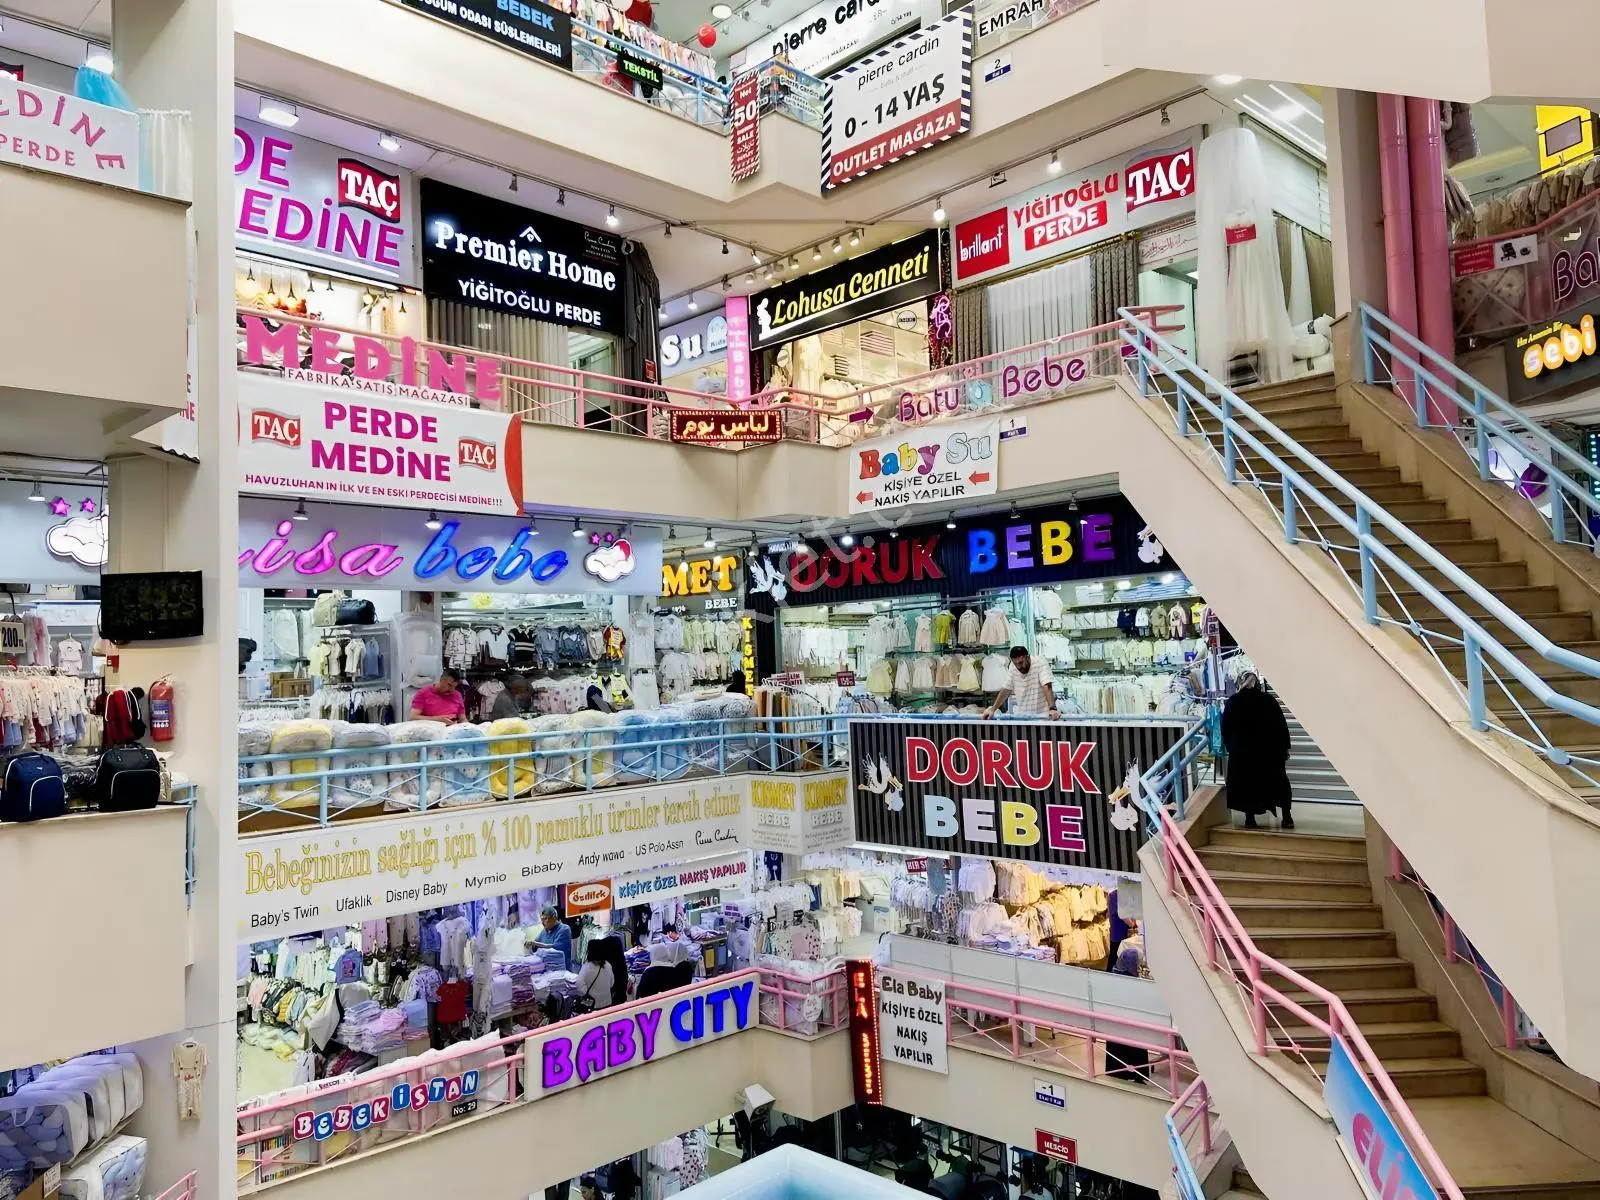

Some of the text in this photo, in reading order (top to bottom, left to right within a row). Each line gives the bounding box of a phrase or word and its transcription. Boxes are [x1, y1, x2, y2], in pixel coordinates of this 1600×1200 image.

[459, 6, 492, 30] ODASI
[494, 20, 562, 59] SÜSLEMELERİ
[622, 60, 660, 83] TEKSTİL
[858, 59, 893, 91] pierre
[898, 37, 940, 67] cardin
[994, 58, 1001, 69] 2
[733, 99, 757, 128] 50
[844, 117, 857, 139] 0
[874, 96, 899, 126] 14
[903, 72, 945, 112] YAŞ
[833, 111, 956, 178] OUTLET MAĞAZA
[341, 167, 398, 218] TAÇ
[1012, 151, 1192, 229] YİĞİTOĞLU TAÇ
[959, 227, 1004, 263] brillant
[1033, 207, 1101, 247] PERDE
[434, 220, 617, 291] Premier Home
[457, 277, 602, 326] YİĞİTOĞLU PERDE
[770, 246, 931, 327] Lohusa Cenneti
[661, 333, 703, 367] Su
[287, 368, 351, 389] FABRİKA
[899, 356, 1086, 423] Batu Bebe
[254, 410, 299, 446] TAÇ
[324, 401, 438, 443] PERDE
[682, 414, 769, 436] لباس نوم
[1009, 418, 1015, 428] 1
[460, 442, 495, 470] TAÇ
[859, 432, 992, 480] Baby Su
[339, 481, 355, 494] İLK
[356, 484, 371, 494] VE
[371, 486, 385, 496] EN
[386, 486, 409, 498] ESKİ
[409, 490, 457, 503] PERDECİSİ
[874, 485, 965, 507] NAKIŞ YAPILIR
[884, 471, 962, 492] KİŞİYE ÖZEL
[789, 513, 1116, 593] DORUK BEBE
[704, 597, 738, 609] BEBE
[1, 627, 19, 648] 200
[905, 736, 1102, 795] DORUK
[751, 780, 796, 812] KISMET
[804, 777, 849, 812] KISMET
[757, 811, 790, 828] BEBE
[811, 809, 843, 829] BEBE
[923, 794, 1088, 853] BEBE
[245, 784, 741, 895] Bebeğinizin sağlığı için % 100 pamuklu ürünler tercih ediniz
[251, 909, 290, 928] Baby's
[293, 904, 319, 919] Twin
[336, 894, 373, 913] Ufaklık
[386, 886, 420, 904] Disney
[423, 882, 448, 901] Baby
[465, 872, 507, 890] Mymio
[521, 860, 564, 878] Bibaby
[578, 851, 601, 867] Andy
[635, 844, 648, 857] US
[648, 841, 666, 854] Polo
[666, 839, 685, 851] Assn
[618, 860, 747, 899] KİŞİYE ÖZEL NAKIŞ YAPILIR
[881, 976, 943, 1005] Ela Baby
[881, 1000, 944, 1025] KİŞİYE ÖZEL
[541, 981, 754, 1089] BABY CITY
[896, 1025, 928, 1046] NAKIŞ
[893, 1045, 934, 1066] YAPILIR
